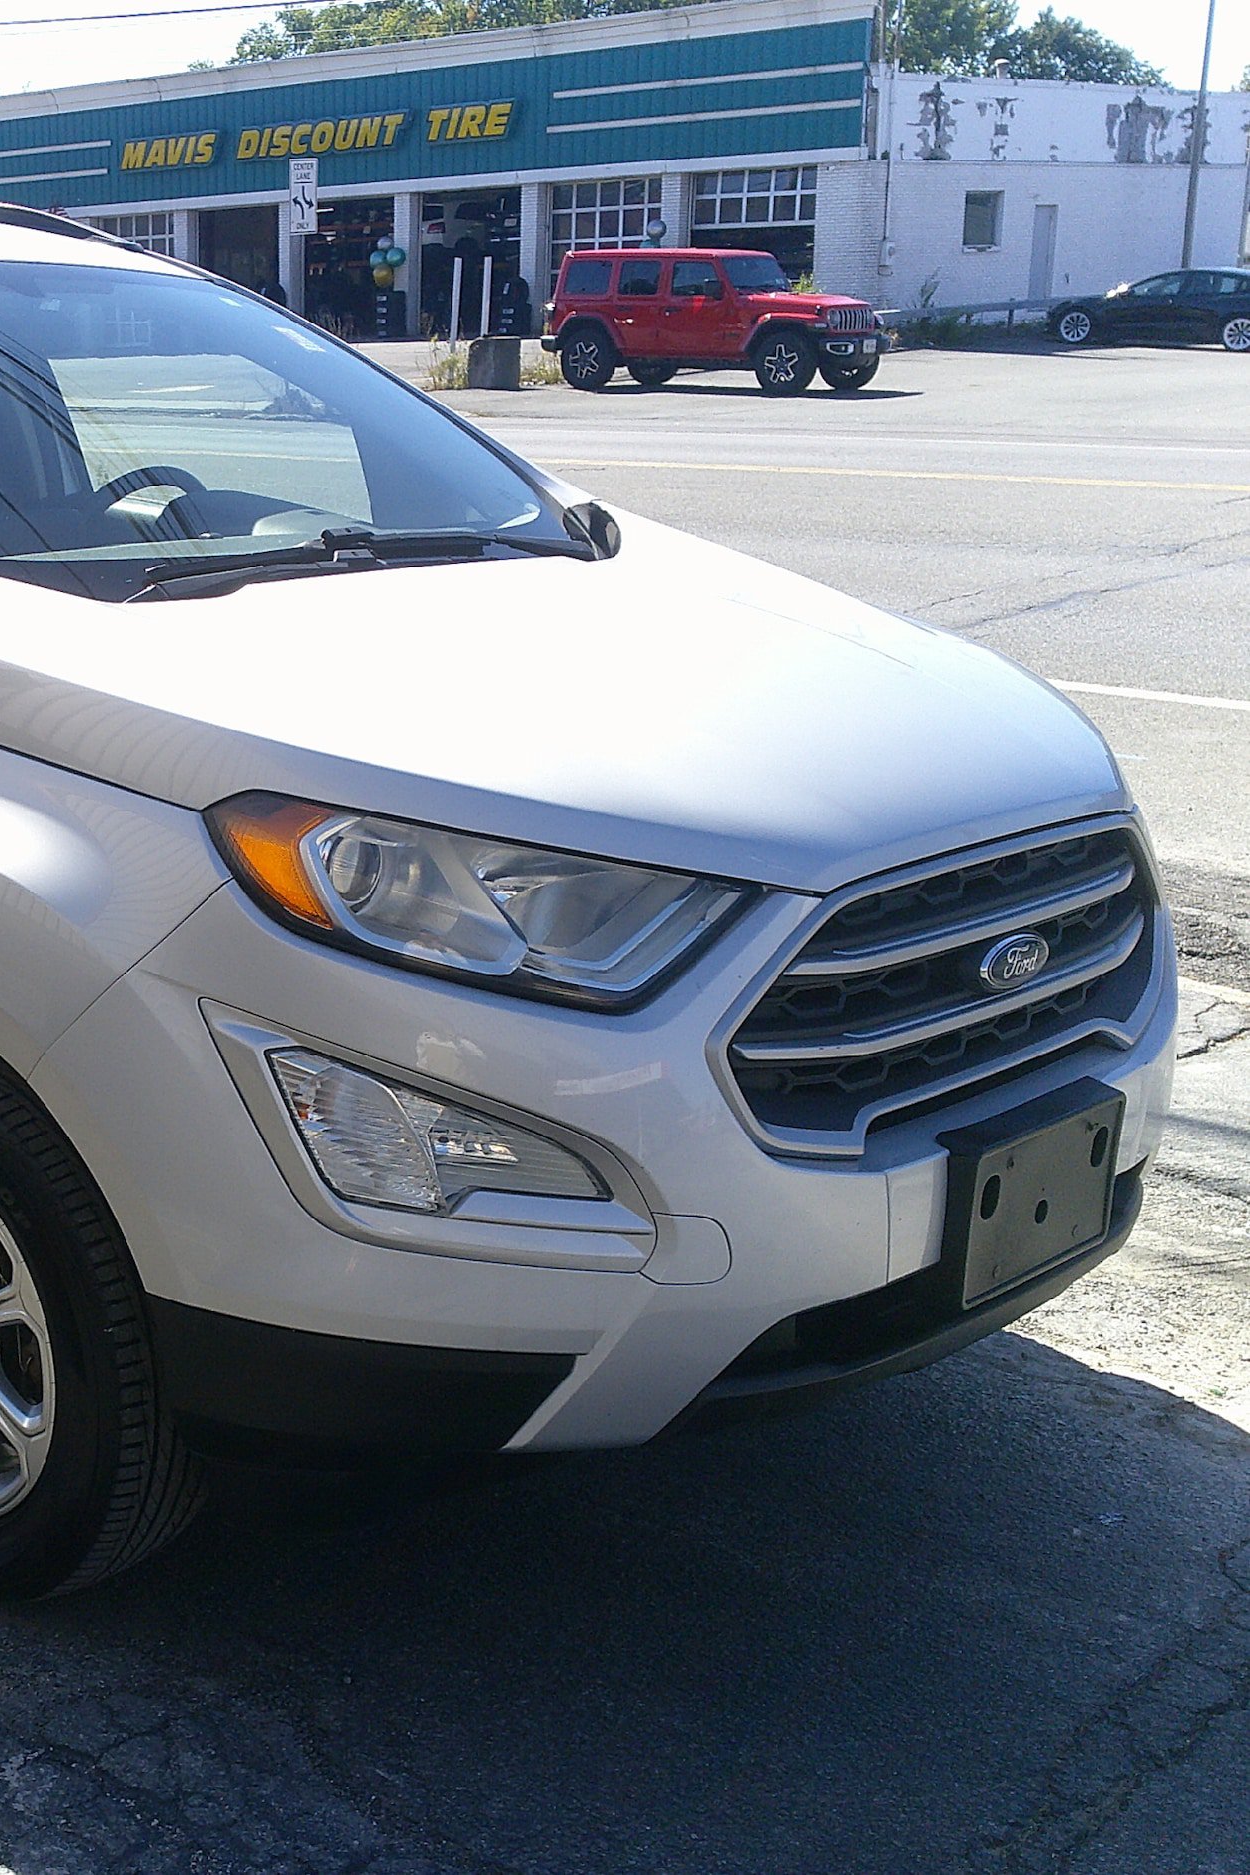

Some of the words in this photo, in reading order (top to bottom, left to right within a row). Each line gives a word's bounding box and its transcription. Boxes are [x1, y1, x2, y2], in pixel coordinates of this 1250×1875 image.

[121, 134, 217, 169] MAVIS
[237, 113, 405, 160] DISCOUNT
[428, 103, 513, 141] TIRE
[293, 163, 314, 171] CENTER
[296, 172, 311, 180] LANE
[296, 222, 309, 230] ONLY
[1004, 944, 1039, 979] Ford
